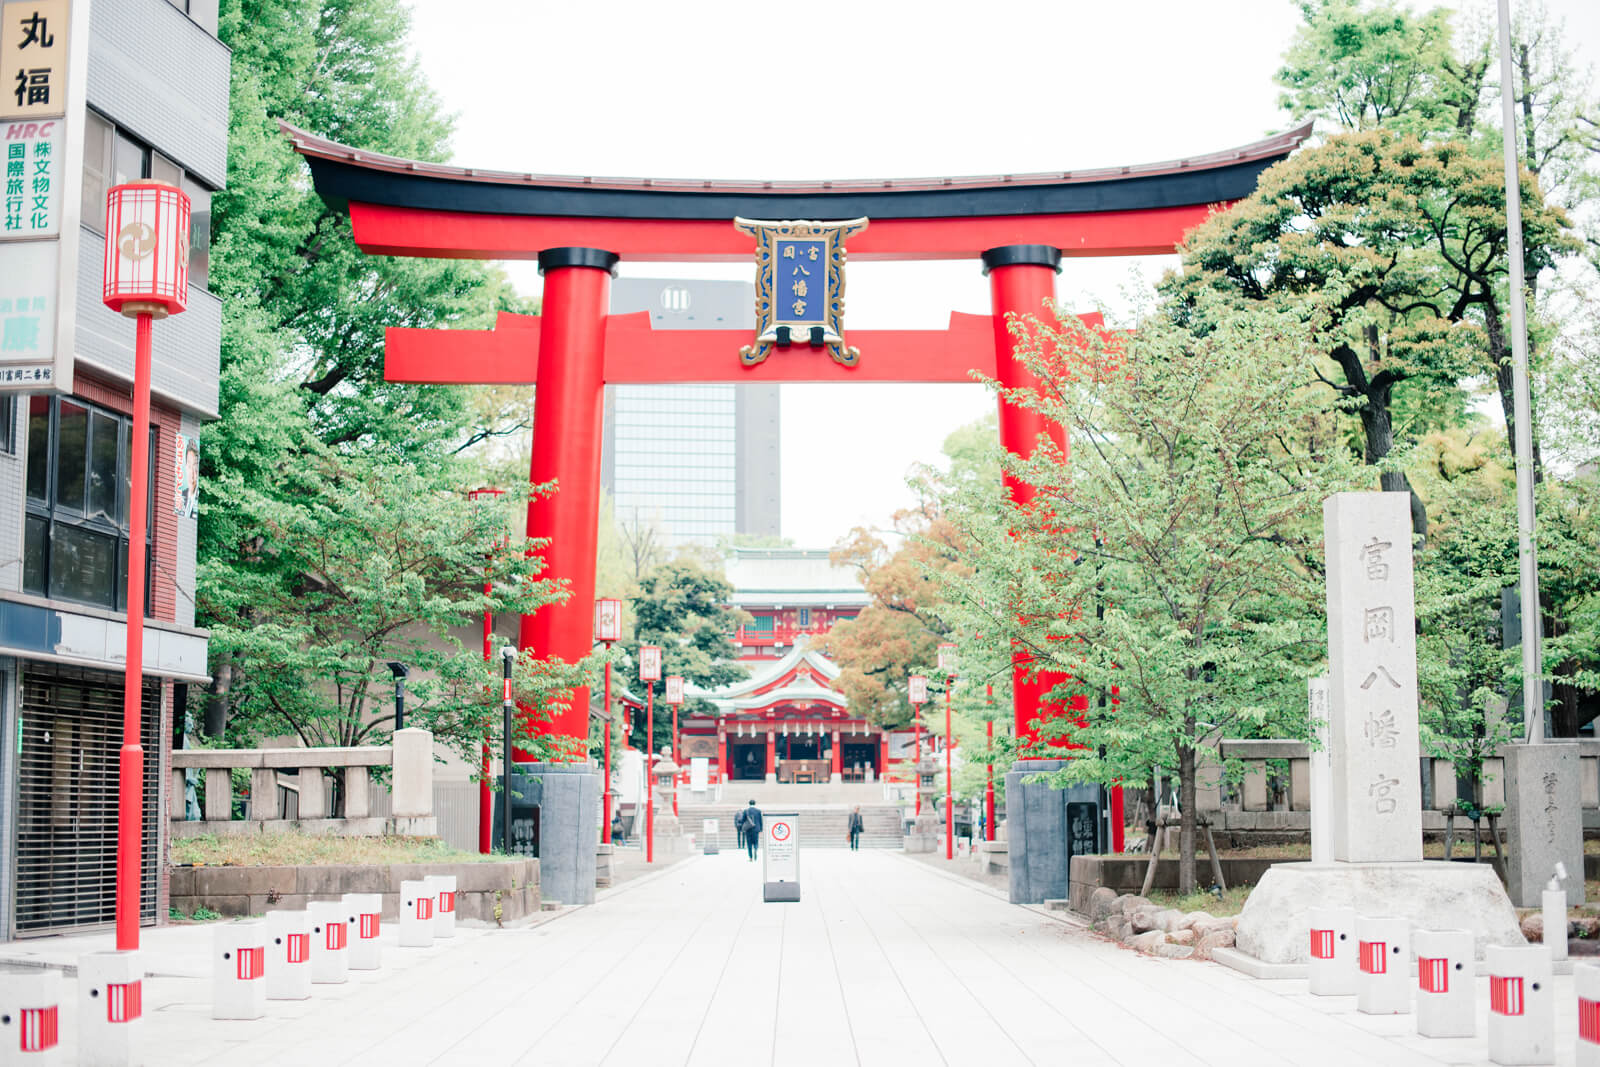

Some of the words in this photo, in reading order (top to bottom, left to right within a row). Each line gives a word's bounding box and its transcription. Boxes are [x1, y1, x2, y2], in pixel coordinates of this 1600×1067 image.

[14, 11, 54, 107] 丸福
[6, 122, 55, 140] HRC
[5, 142, 25, 231] 国際旅行社
[1359, 536, 1401, 815] 富岡八幡宮
